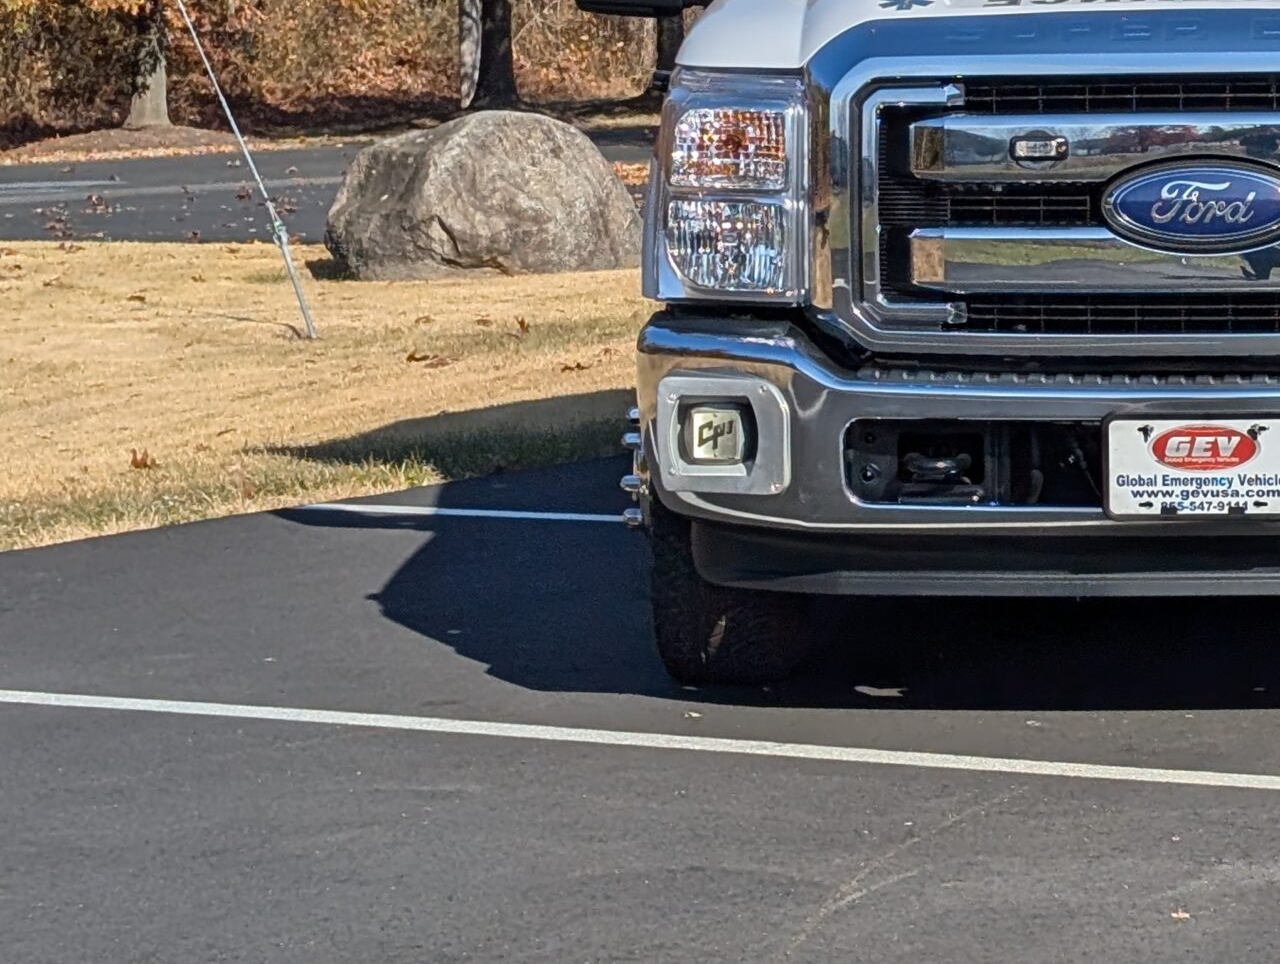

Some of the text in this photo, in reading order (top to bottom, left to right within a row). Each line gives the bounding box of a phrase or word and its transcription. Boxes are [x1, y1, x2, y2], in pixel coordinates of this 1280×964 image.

[1150, 180, 1257, 224] Ford
[1164, 436, 1241, 457] GEV
[1116, 474, 1158, 487] Global
[1162, 474, 1234, 490] Emergency
[1131, 489, 1280, 500] www.gevusa.com
